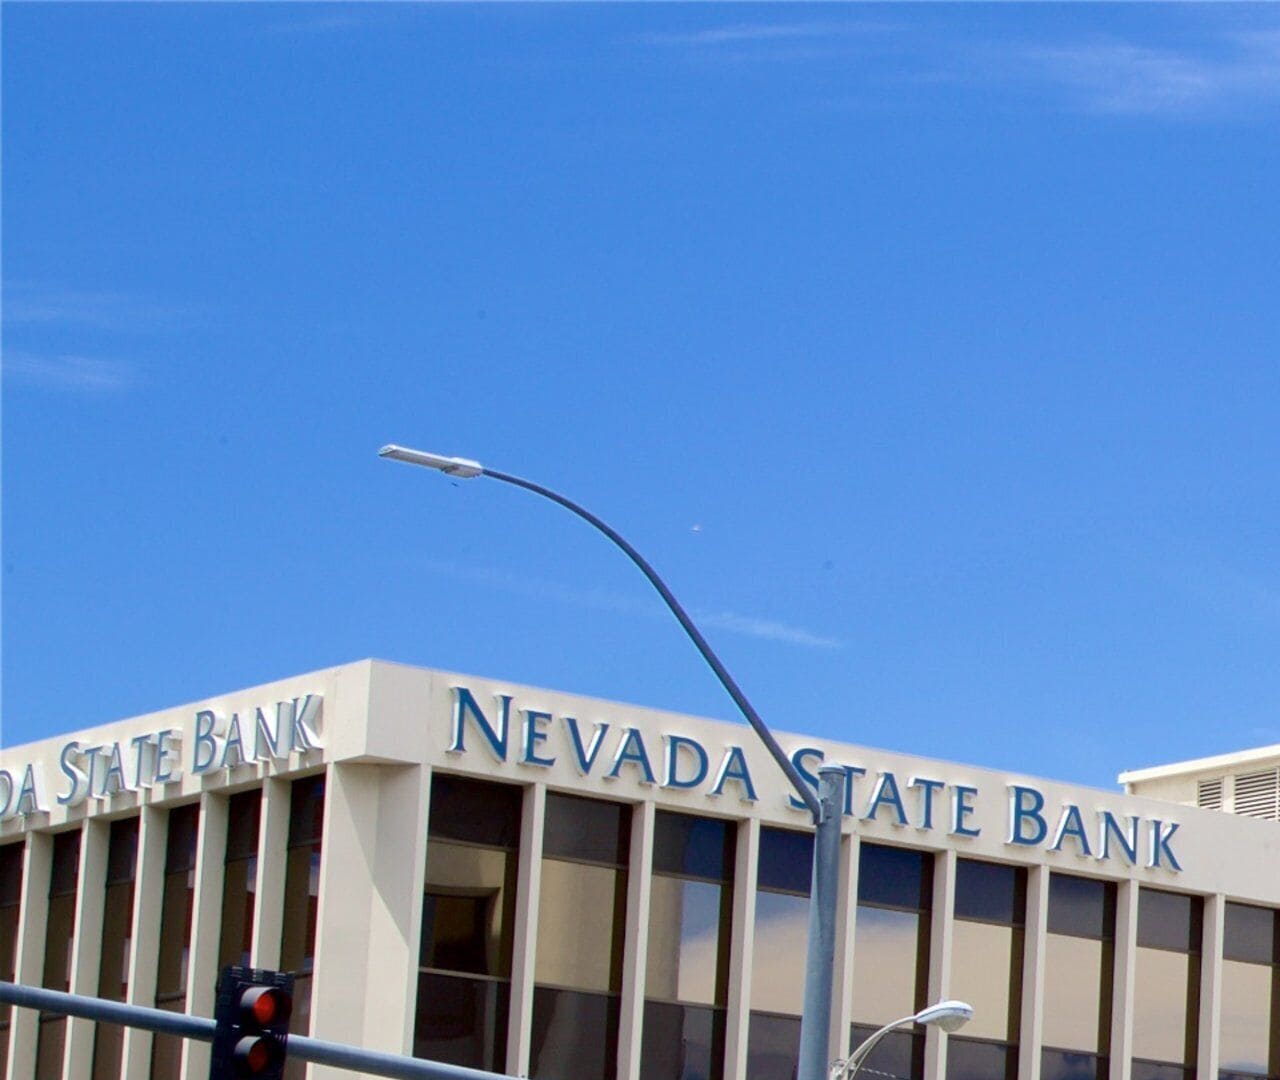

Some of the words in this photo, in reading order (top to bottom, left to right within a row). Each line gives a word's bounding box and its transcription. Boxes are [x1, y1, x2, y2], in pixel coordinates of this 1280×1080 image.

[56, 729, 183, 805] STATE
[192, 694, 324, 776] BANK
[446, 686, 759, 804] NEVADA
[785, 747, 982, 839] STATE
[1005, 784, 1183, 872] BANK
